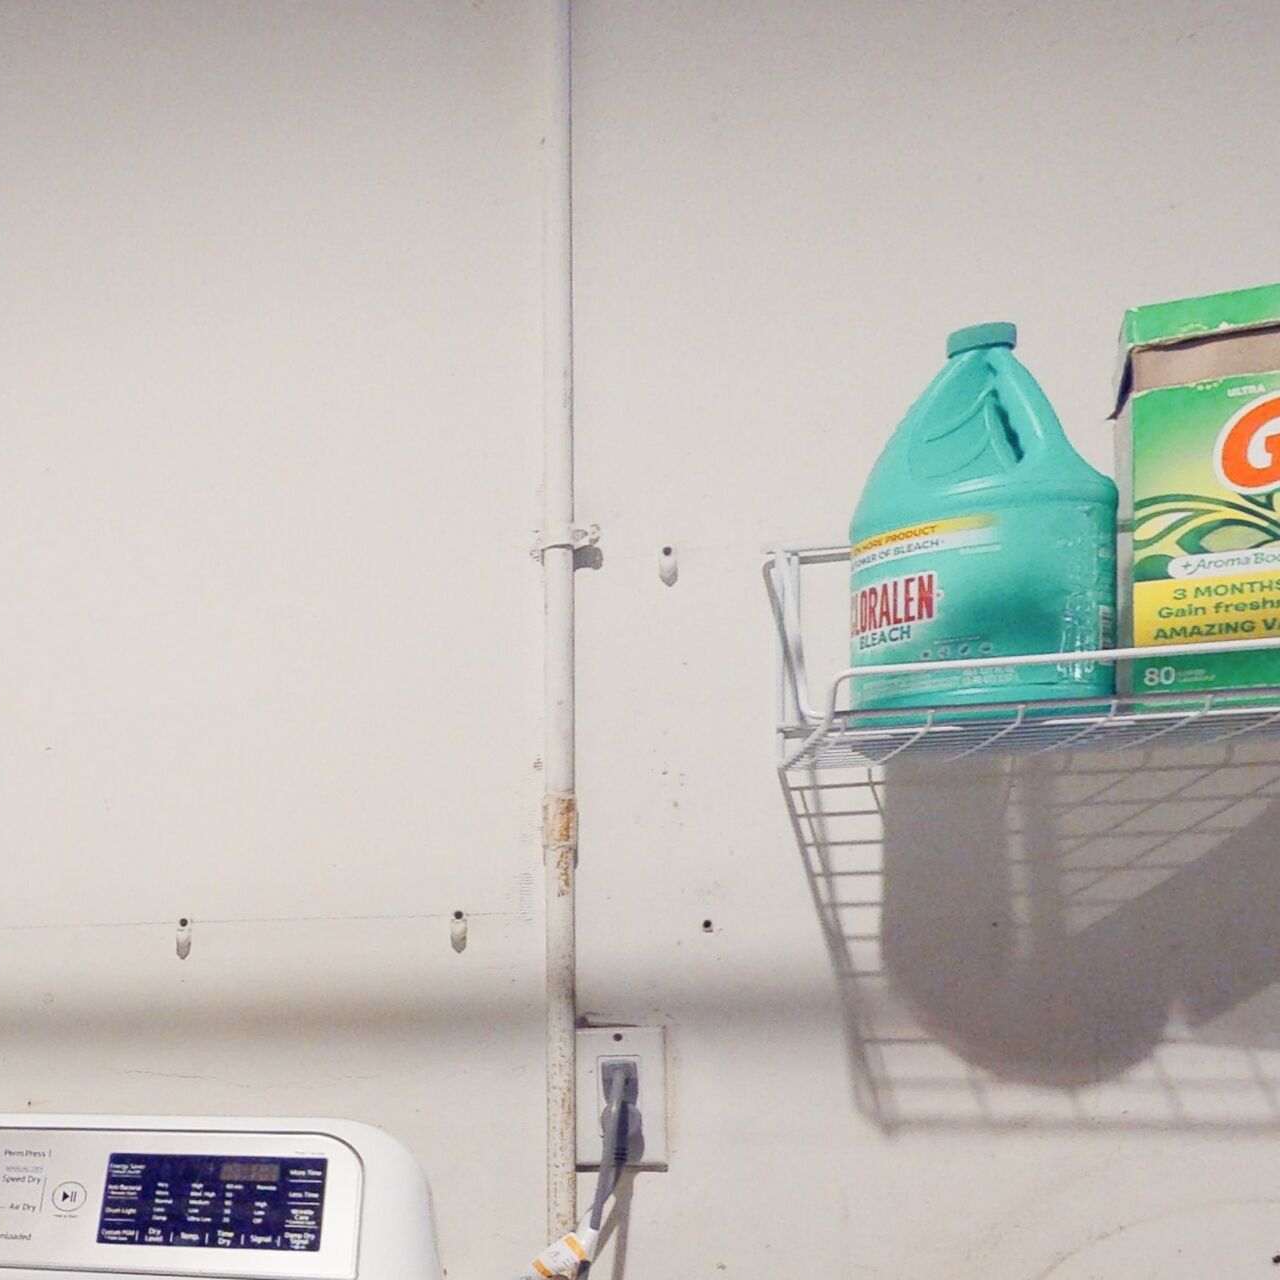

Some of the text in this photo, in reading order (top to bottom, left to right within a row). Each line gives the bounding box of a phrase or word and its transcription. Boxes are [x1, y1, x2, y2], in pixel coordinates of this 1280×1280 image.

[1227, 384, 1266, 397] ULTRA
[884, 525, 937, 543] PRODUCT
[878, 548, 893, 560] OF
[1187, 557, 1250, 575] Aroma
[1173, 588, 1187, 600] 3
[1158, 603, 1207, 619] Gain
[1154, 620, 1256, 640] AMAZING
[860, 624, 911, 650] BLEACH
[1144, 666, 1176, 686] 80
[2, 1174, 41, 1184] Speed Dry
[9, 1202, 36, 1213] Air Dry
[148, 1227, 162, 1236] Dry
[217, 1230, 235, 1238] Time
[303, 1232, 316, 1240] Dry
[218, 1237, 232, 1246] Dry
[250, 1234, 273, 1244] Signal
